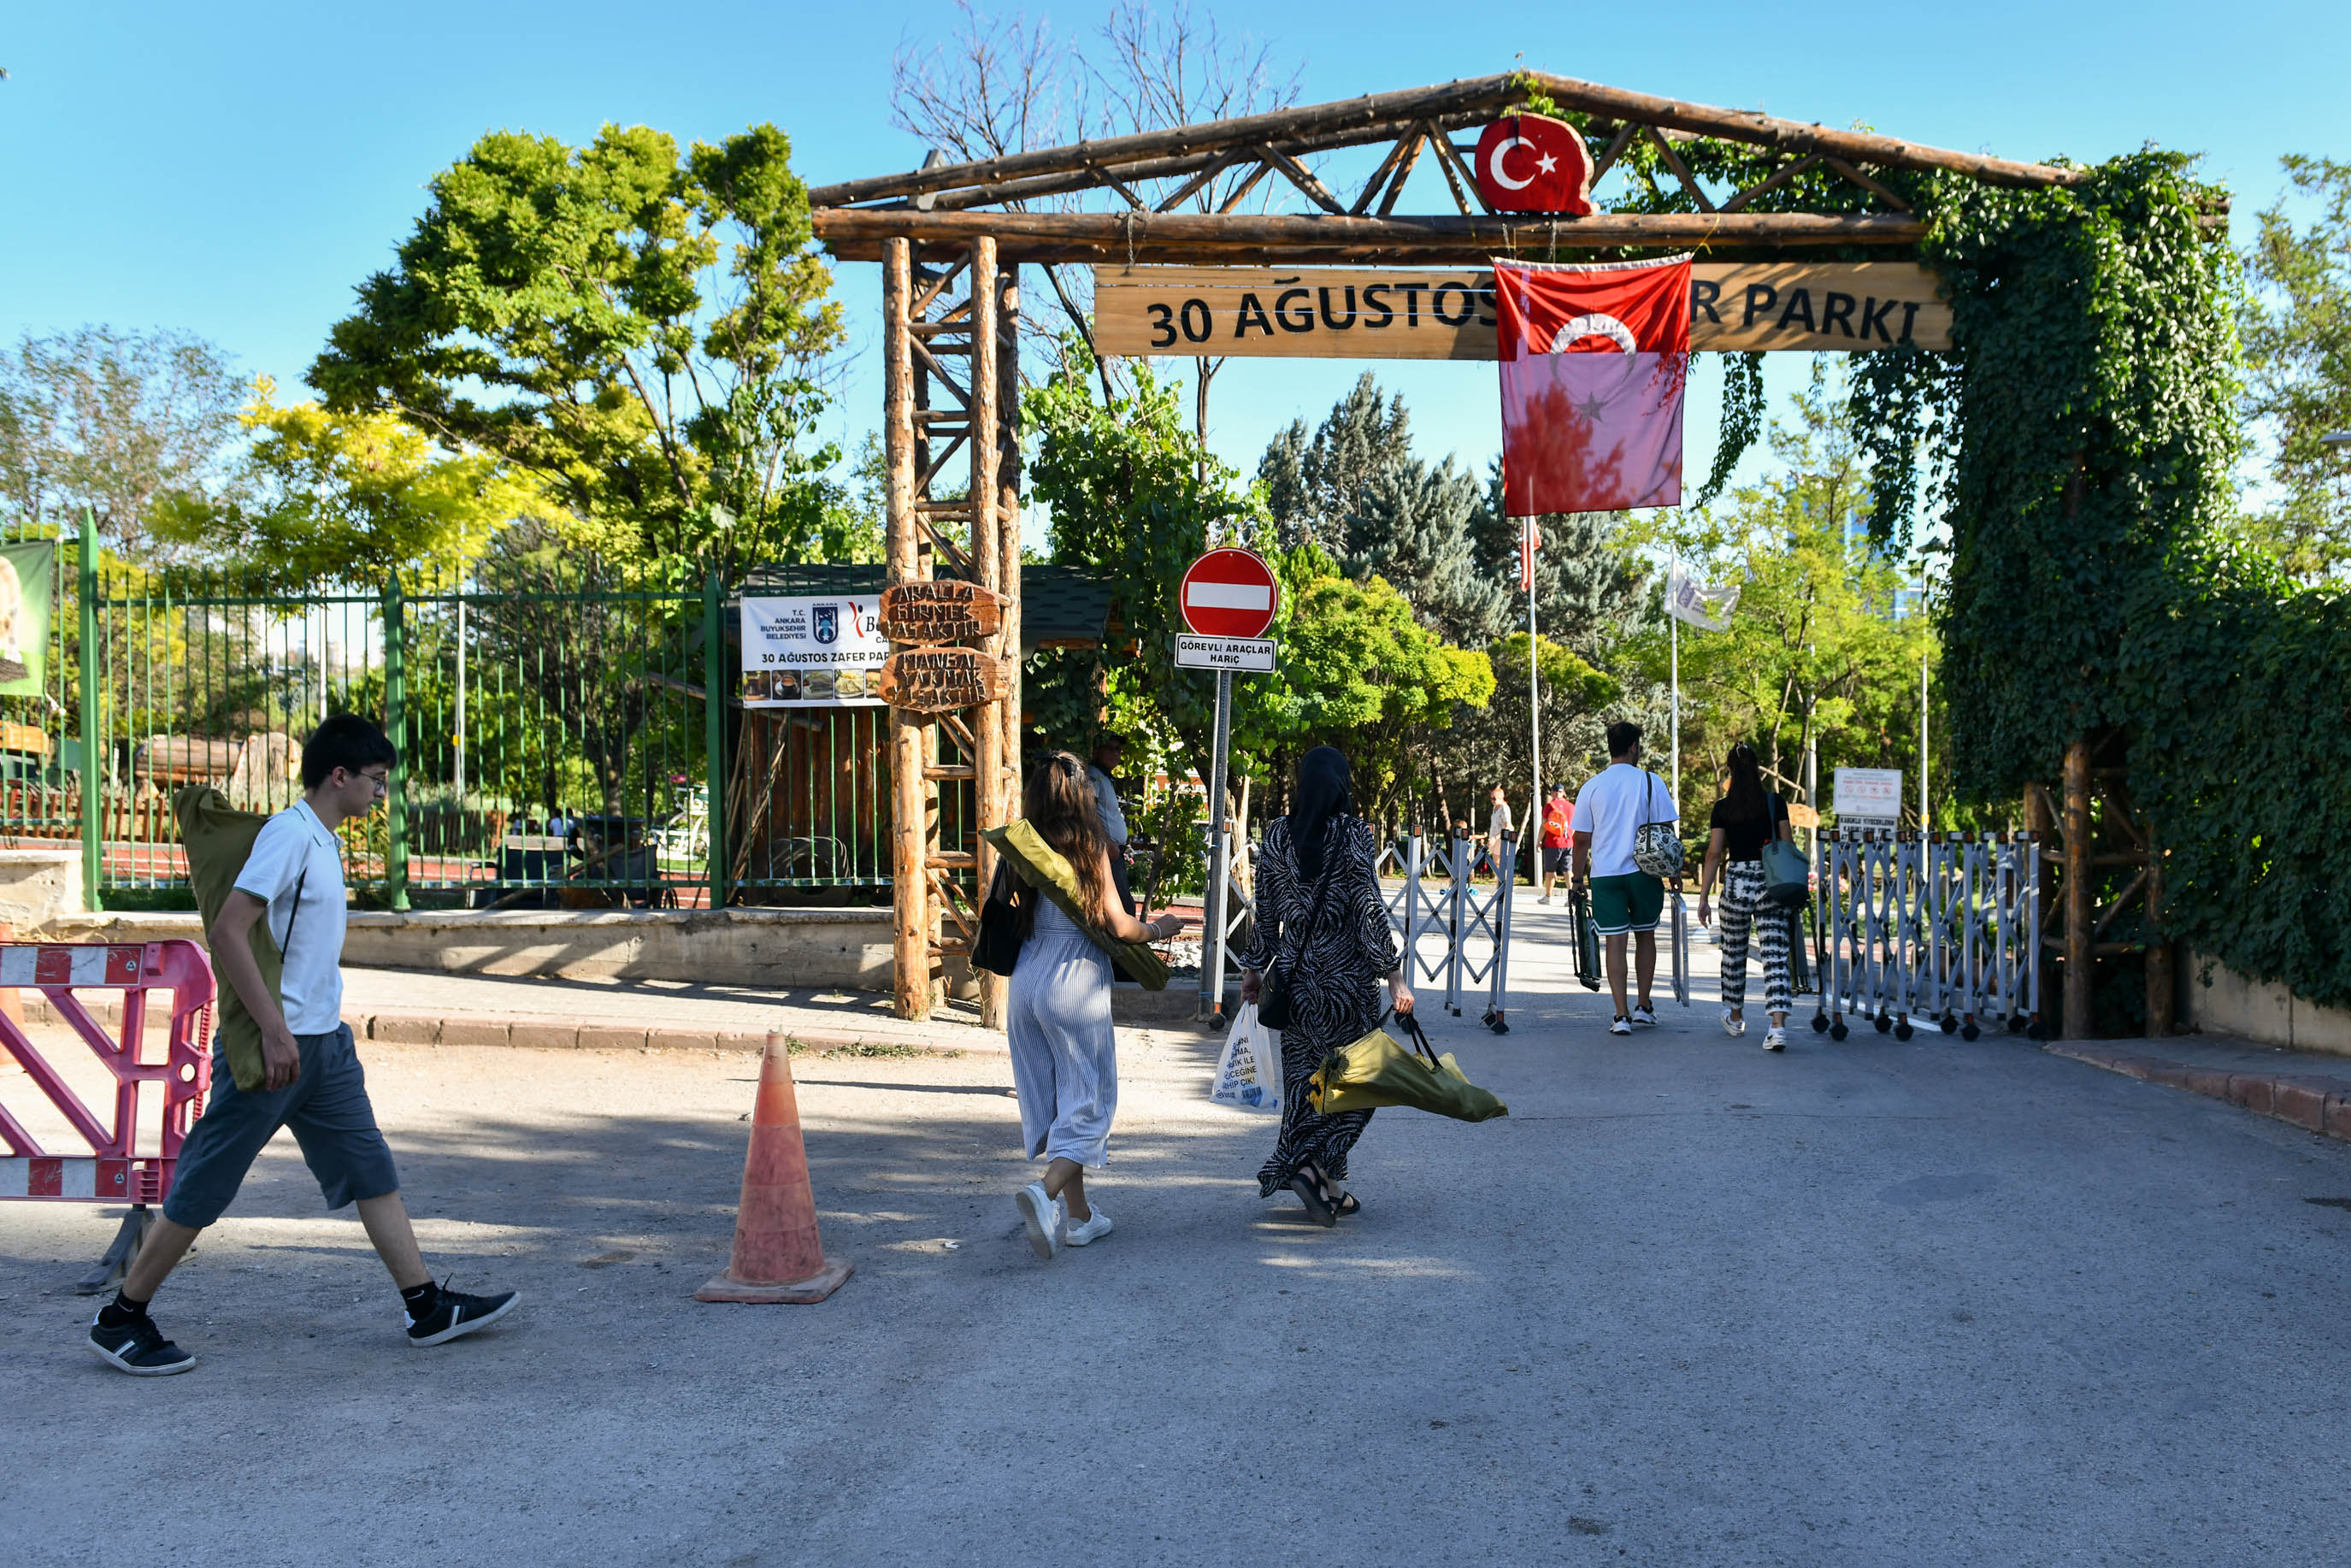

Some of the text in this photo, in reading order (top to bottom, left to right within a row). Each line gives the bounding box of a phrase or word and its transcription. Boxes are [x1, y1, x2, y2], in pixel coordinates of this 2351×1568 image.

[1147, 298, 1213, 348] 30
[1743, 284, 1921, 344] PARKI
[1226, 644, 1271, 656] ARAÇLAR
[762, 654, 775, 663] 30
[779, 651, 828, 663] AĞUSTOS
[831, 653, 865, 662] ZAFER
[1243, 1055, 1255, 1064] İLE
[1240, 1077, 1256, 1088] ÇIK!
